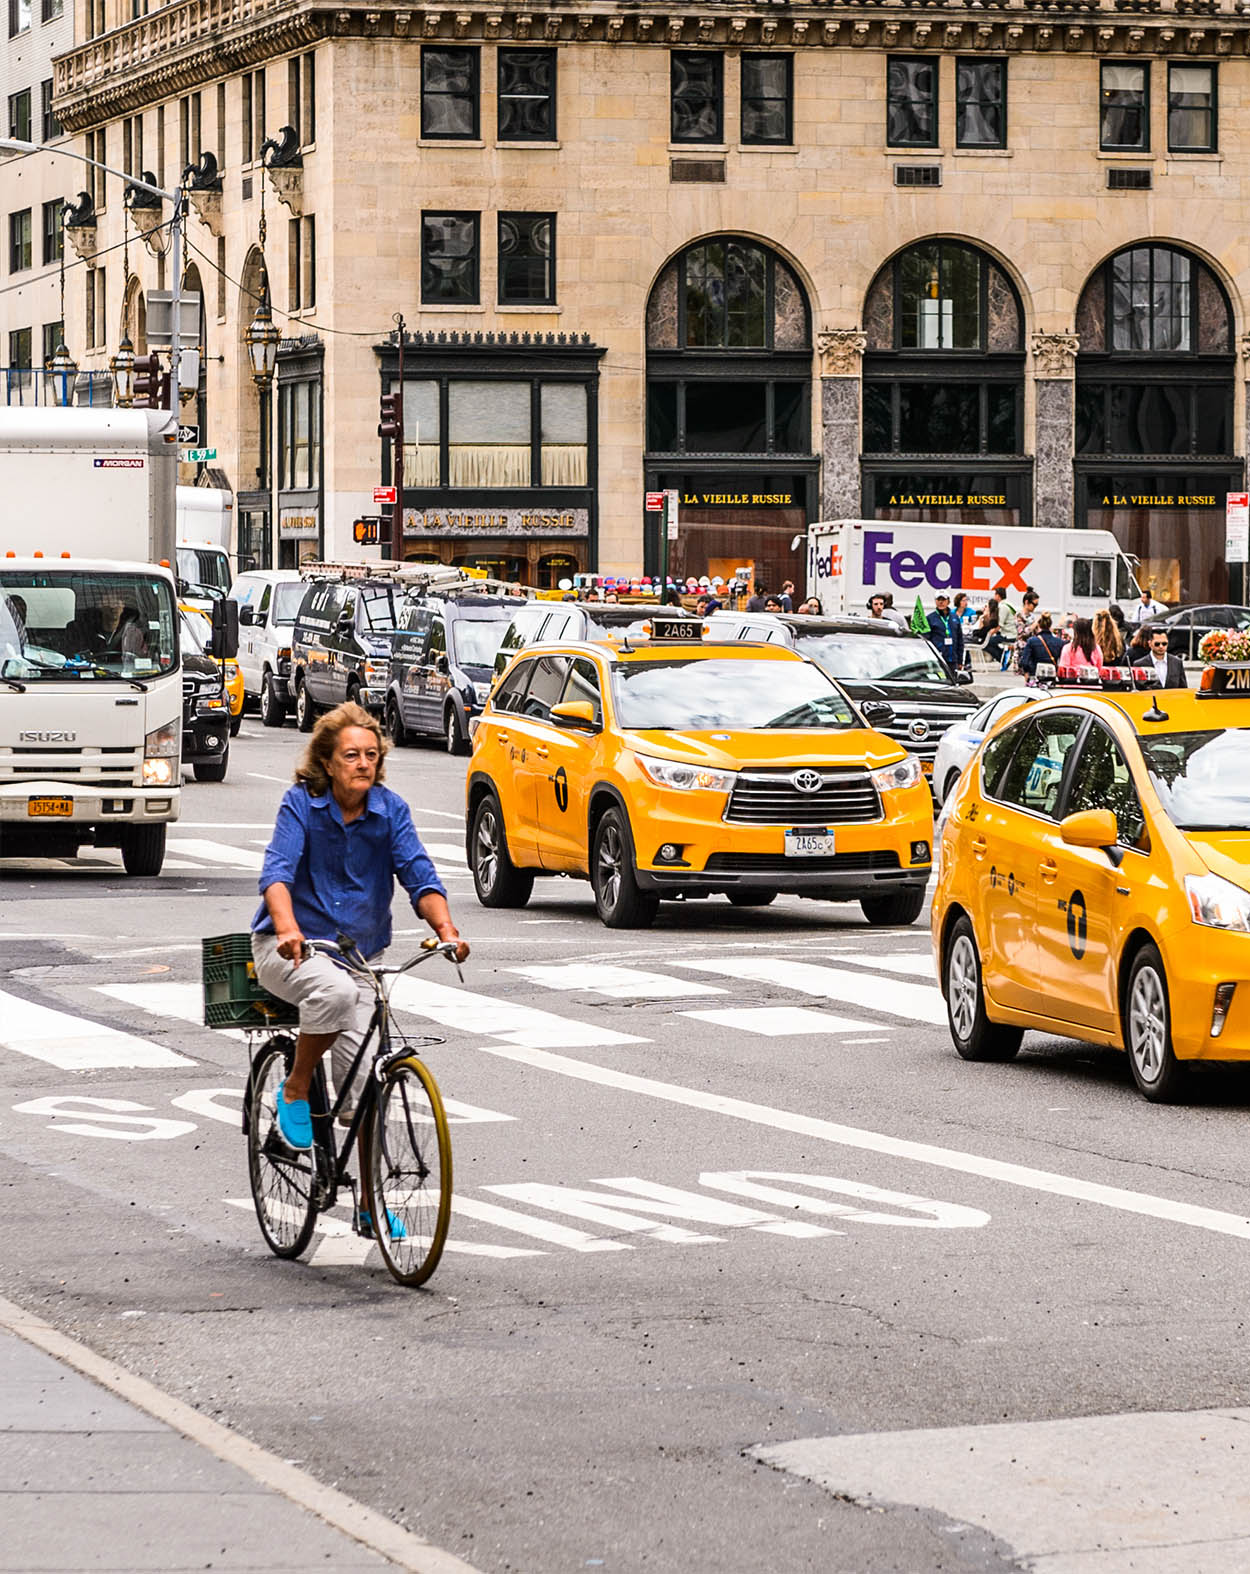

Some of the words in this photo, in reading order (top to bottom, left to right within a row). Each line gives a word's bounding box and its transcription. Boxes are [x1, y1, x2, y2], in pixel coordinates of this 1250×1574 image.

[189, 450, 195, 460] E
[197, 449, 206, 460] 59
[102, 460, 142, 468] MORGAN
[684, 494, 699, 504] LA
[703, 494, 749, 504] VIEILLE
[752, 494, 792, 504] RUSSIE
[889, 495, 898, 505] A
[900, 495, 915, 505] LA
[917, 495, 964, 505] VIEILLE
[967, 495, 1006, 505] RUSSIE
[1102, 496, 1110, 505] A
[1113, 496, 1127, 505] LA
[1132, 496, 1175, 505] VIEILLE
[1178, 496, 1216, 505] RUSSIE
[406, 514, 417, 528] A
[423, 514, 443, 528] LA
[447, 514, 508, 528] VIEILLE
[521, 514, 575, 528] RUSSIE
[810, 544, 843, 579] FedEx
[862, 531, 1034, 592] FedEx
[664, 623, 693, 638] 2A65
[19, 731, 77, 742] ISUZU
